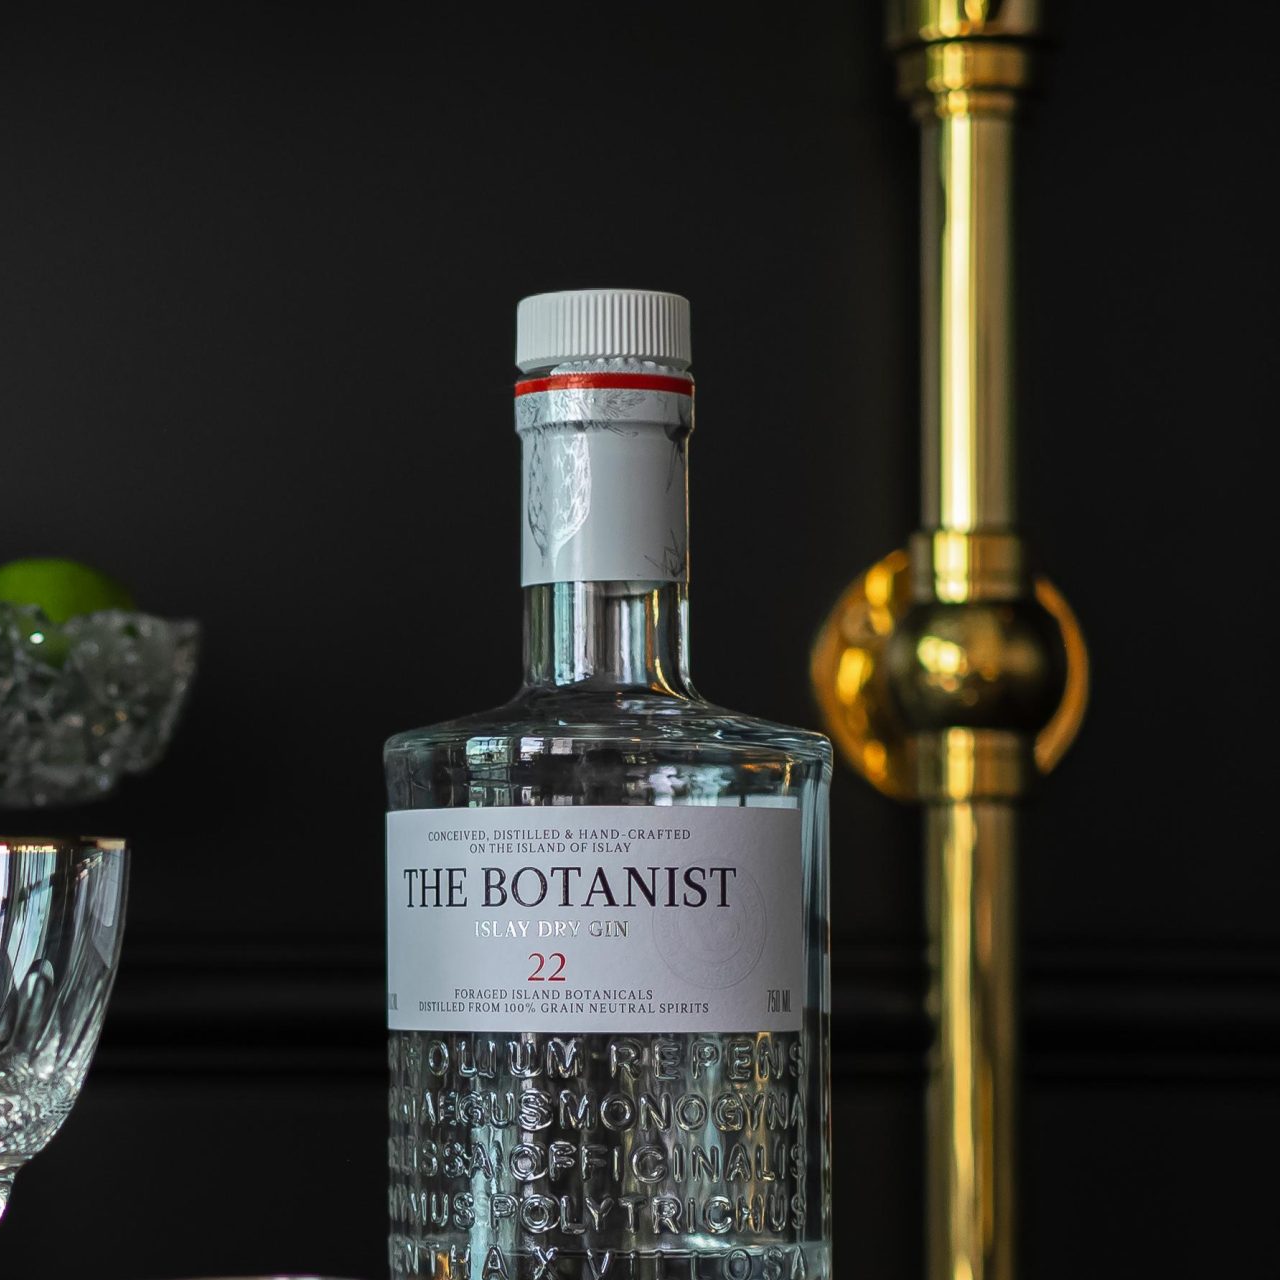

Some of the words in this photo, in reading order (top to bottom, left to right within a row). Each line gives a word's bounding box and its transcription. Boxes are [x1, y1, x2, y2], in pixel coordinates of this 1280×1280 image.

[428, 830, 490, 842] CONCEIVED,
[493, 829, 560, 840] DISTILLED
[564, 828, 574, 840] &
[579, 828, 691, 840] HAND-CRAFTED
[469, 843, 486, 854] ON
[489, 843, 513, 853] THE
[517, 842, 566, 853] ISLAND
[570, 842, 588, 853] OF
[592, 842, 632, 853] ISLAY
[403, 867, 468, 908] THE
[481, 866, 737, 908] BOTANIST
[474, 919, 530, 938] ISLAY
[538, 920, 581, 938] DRY
[588, 920, 630, 938] GIN
[527, 952, 567, 982] 22
[454, 988, 508, 1000] FORAGED
[512, 989, 560, 1000] ISLAND
[565, 989, 654, 1000] BOTANICALS
[767, 989, 780, 1013] 750
[418, 1000, 465, 1012] DISTILLED
[468, 1002, 500, 1013] FROM
[504, 1002, 536, 1013] 100%
[540, 1003, 584, 1013] GRAIN
[589, 1003, 656, 1014] NEUTRAL
[659, 1002, 710, 1014] SPIRITS
[509, 1143, 806, 1184] OFFICINALIS
